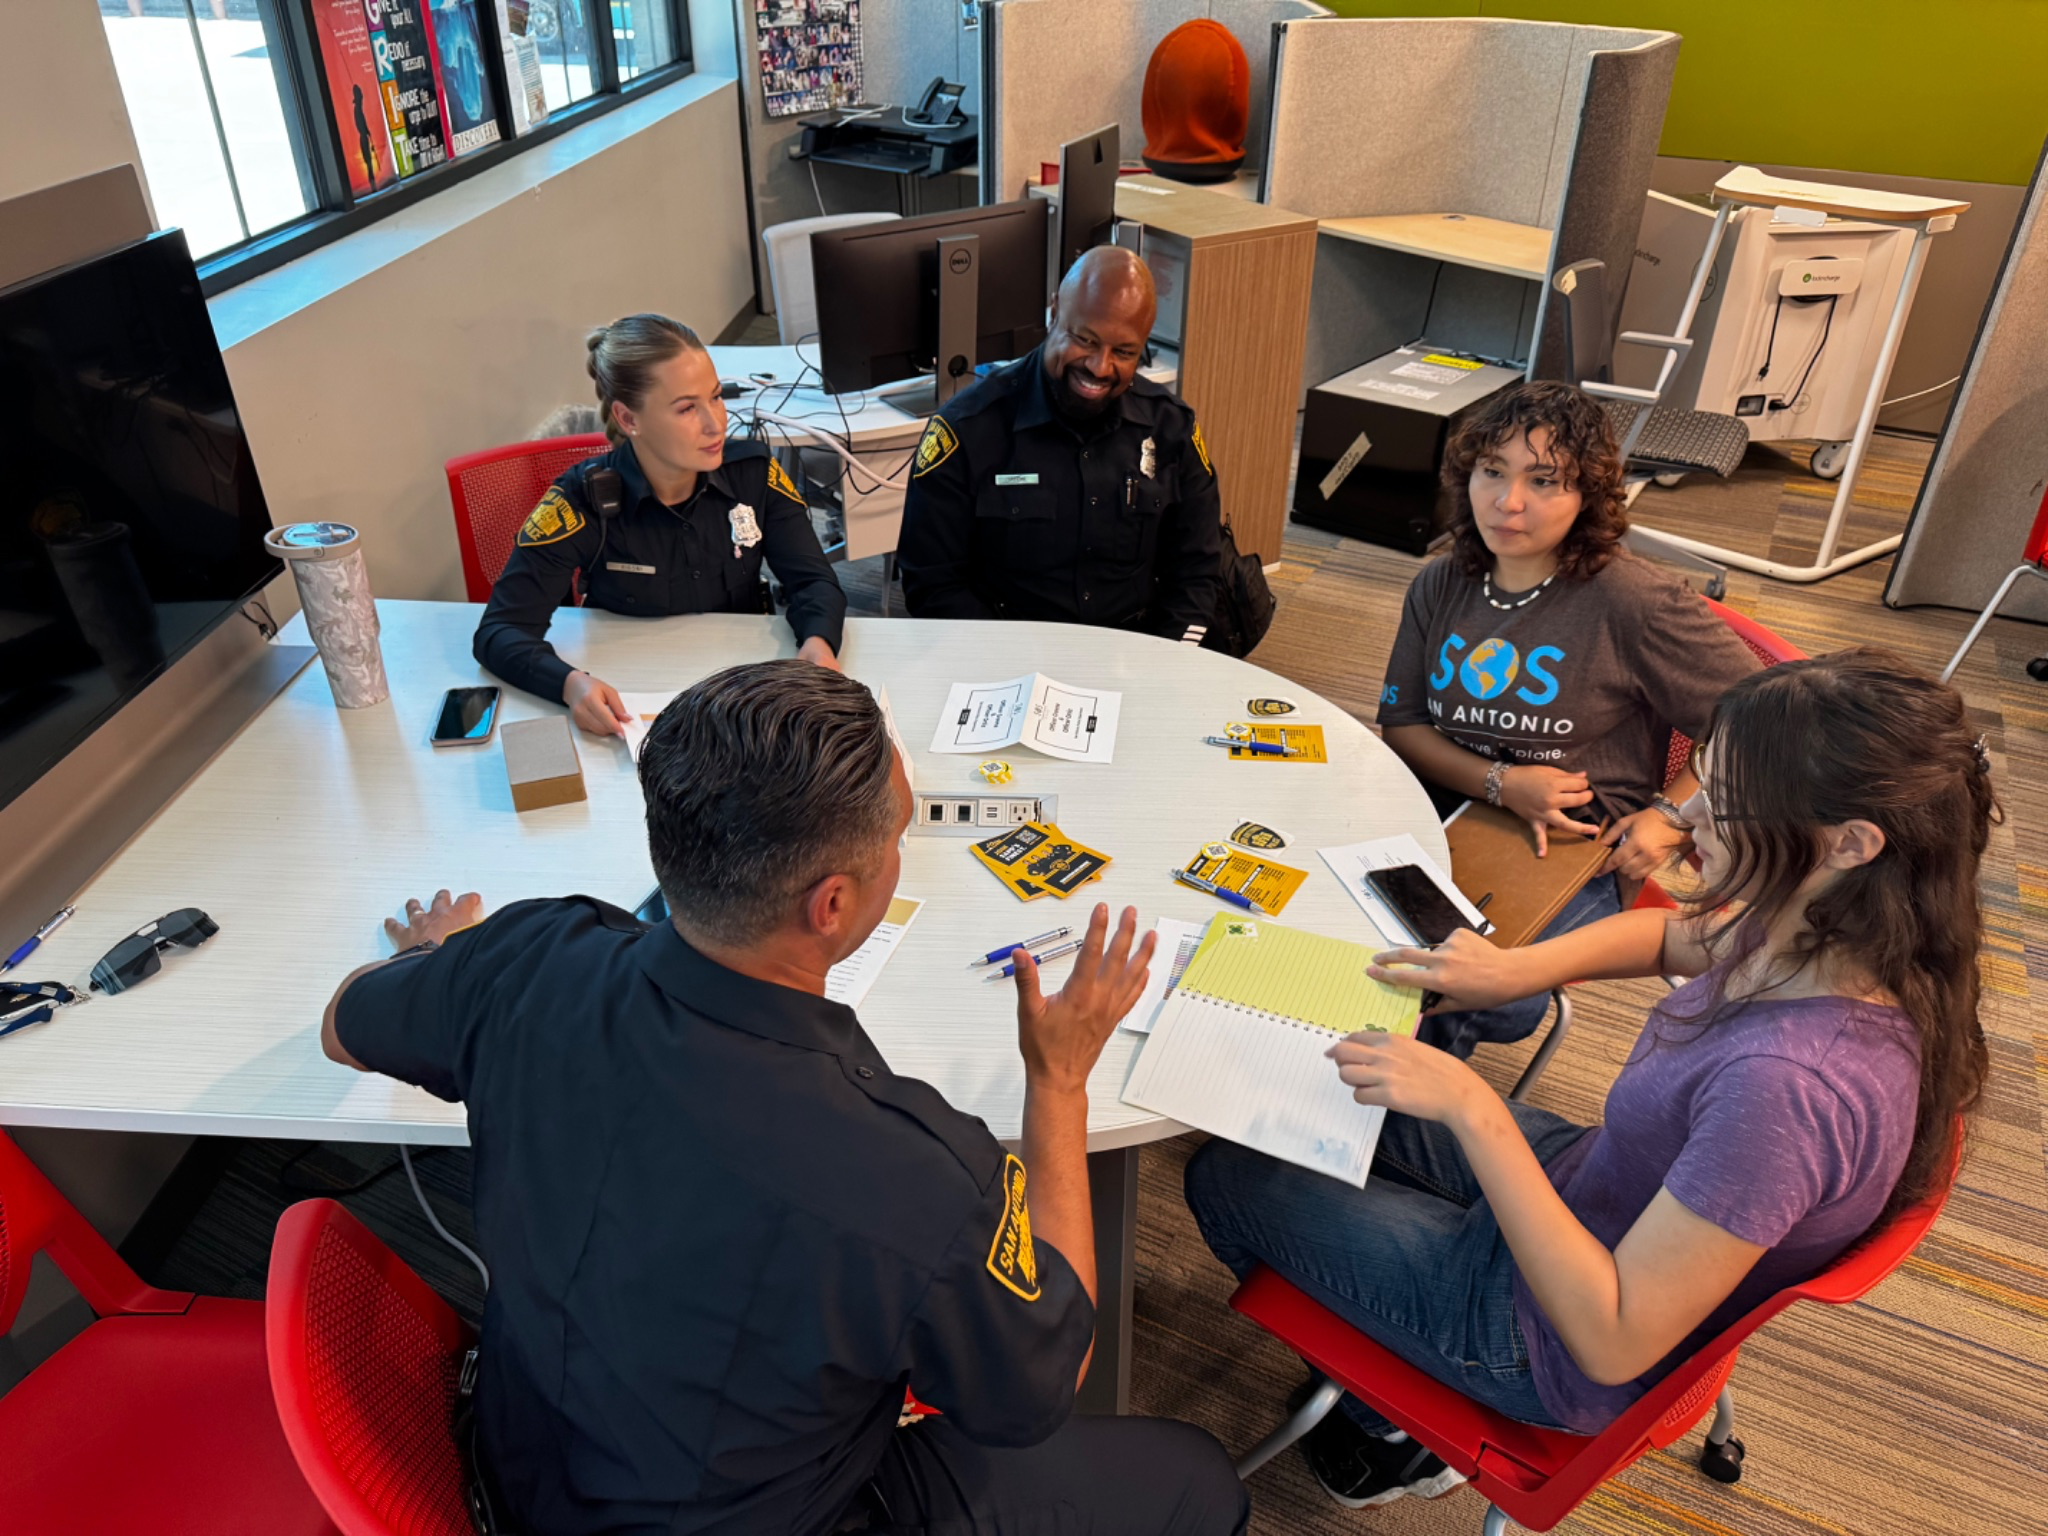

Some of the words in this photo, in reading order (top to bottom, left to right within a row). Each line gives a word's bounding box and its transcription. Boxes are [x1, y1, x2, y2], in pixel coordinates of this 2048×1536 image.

[952, 258, 968, 266] DELL
[1430, 633, 1566, 706] SOS
[1453, 705, 1574, 735] ANTONIO
[1000, 1226, 1017, 1275] SAN
